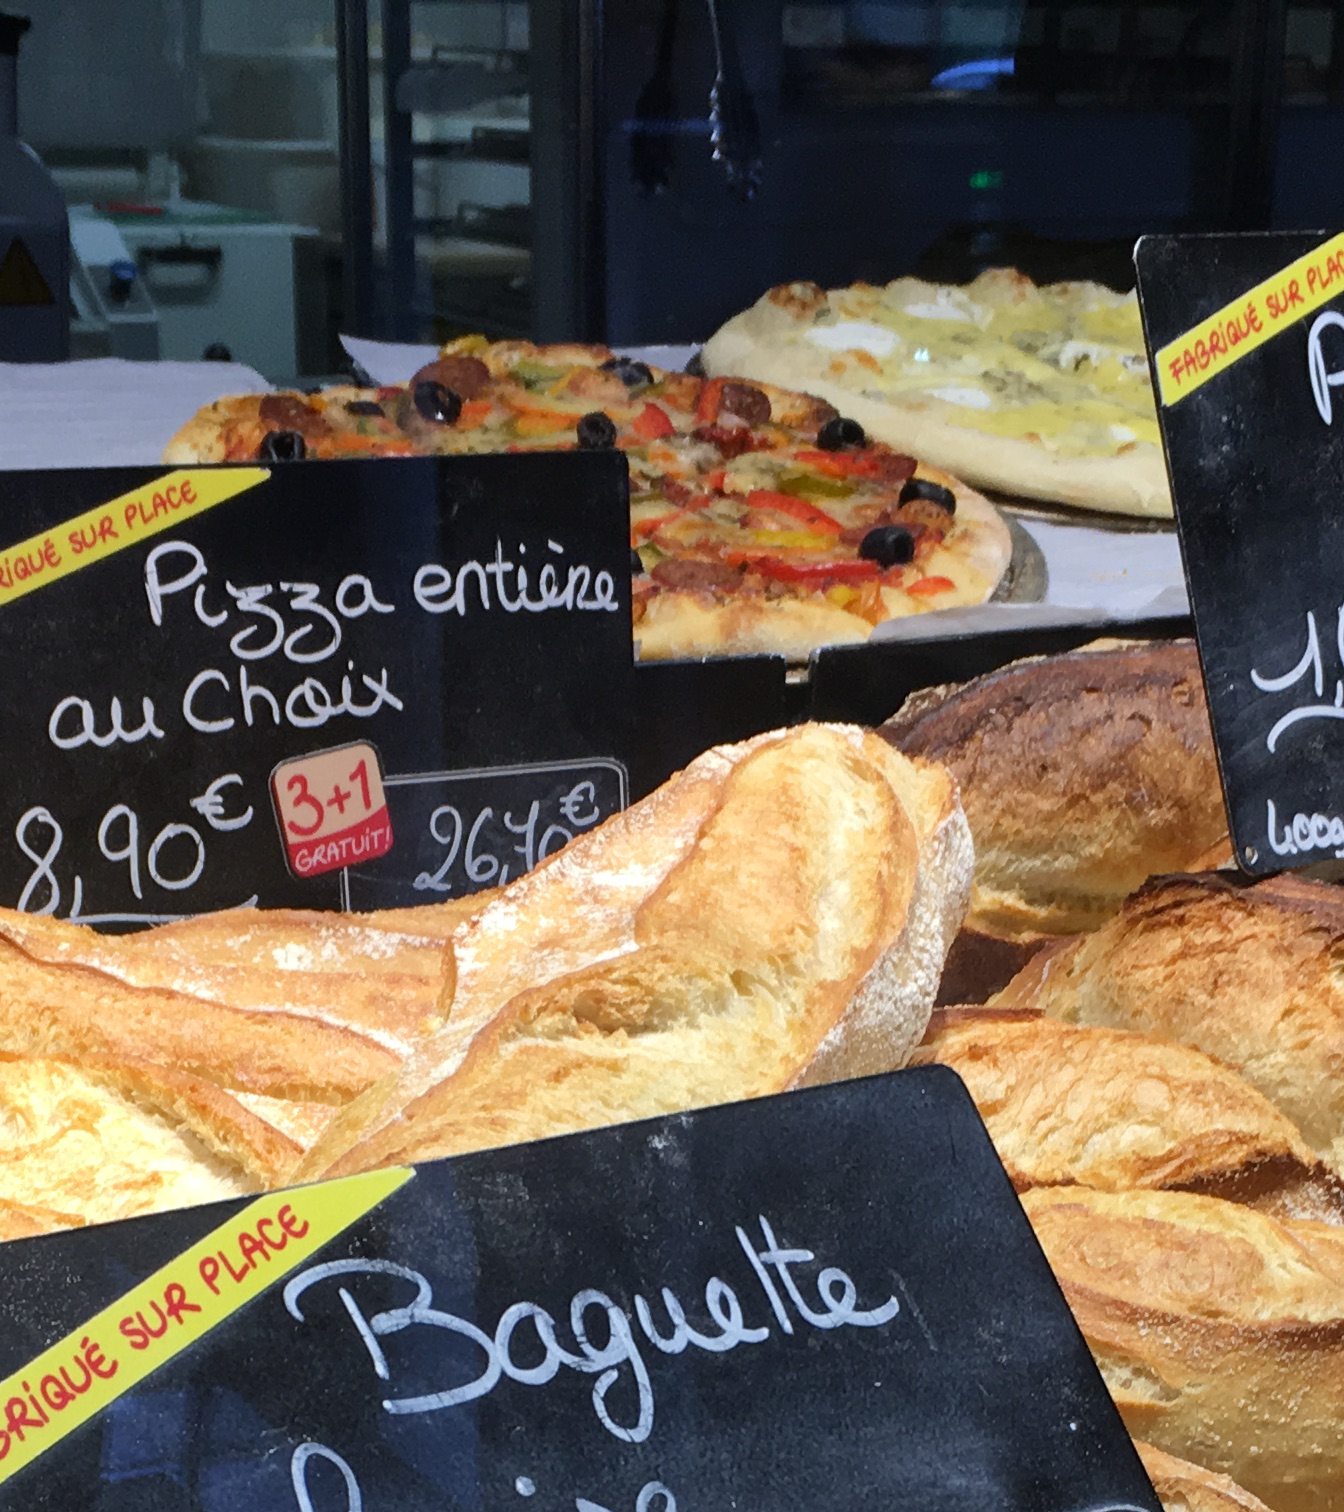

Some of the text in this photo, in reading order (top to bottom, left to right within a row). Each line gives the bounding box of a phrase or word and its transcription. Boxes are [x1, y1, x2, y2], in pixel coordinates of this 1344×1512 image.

[1169, 301, 1264, 385] FABRIQUÉ
[1265, 279, 1305, 320] SUR
[67, 514, 119, 555] SUR
[124, 479, 198, 530] PLACE
[145, 537, 620, 662] Pizza entière
[48, 660, 405, 750] au Choix
[283, 760, 375, 838] 3+1
[293, 826, 394, 875] GRATUIT!
[118, 1282, 202, 1351] SUR
[198, 1203, 310, 1296] PLACE
[284, 1215, 901, 1442] Baguette
